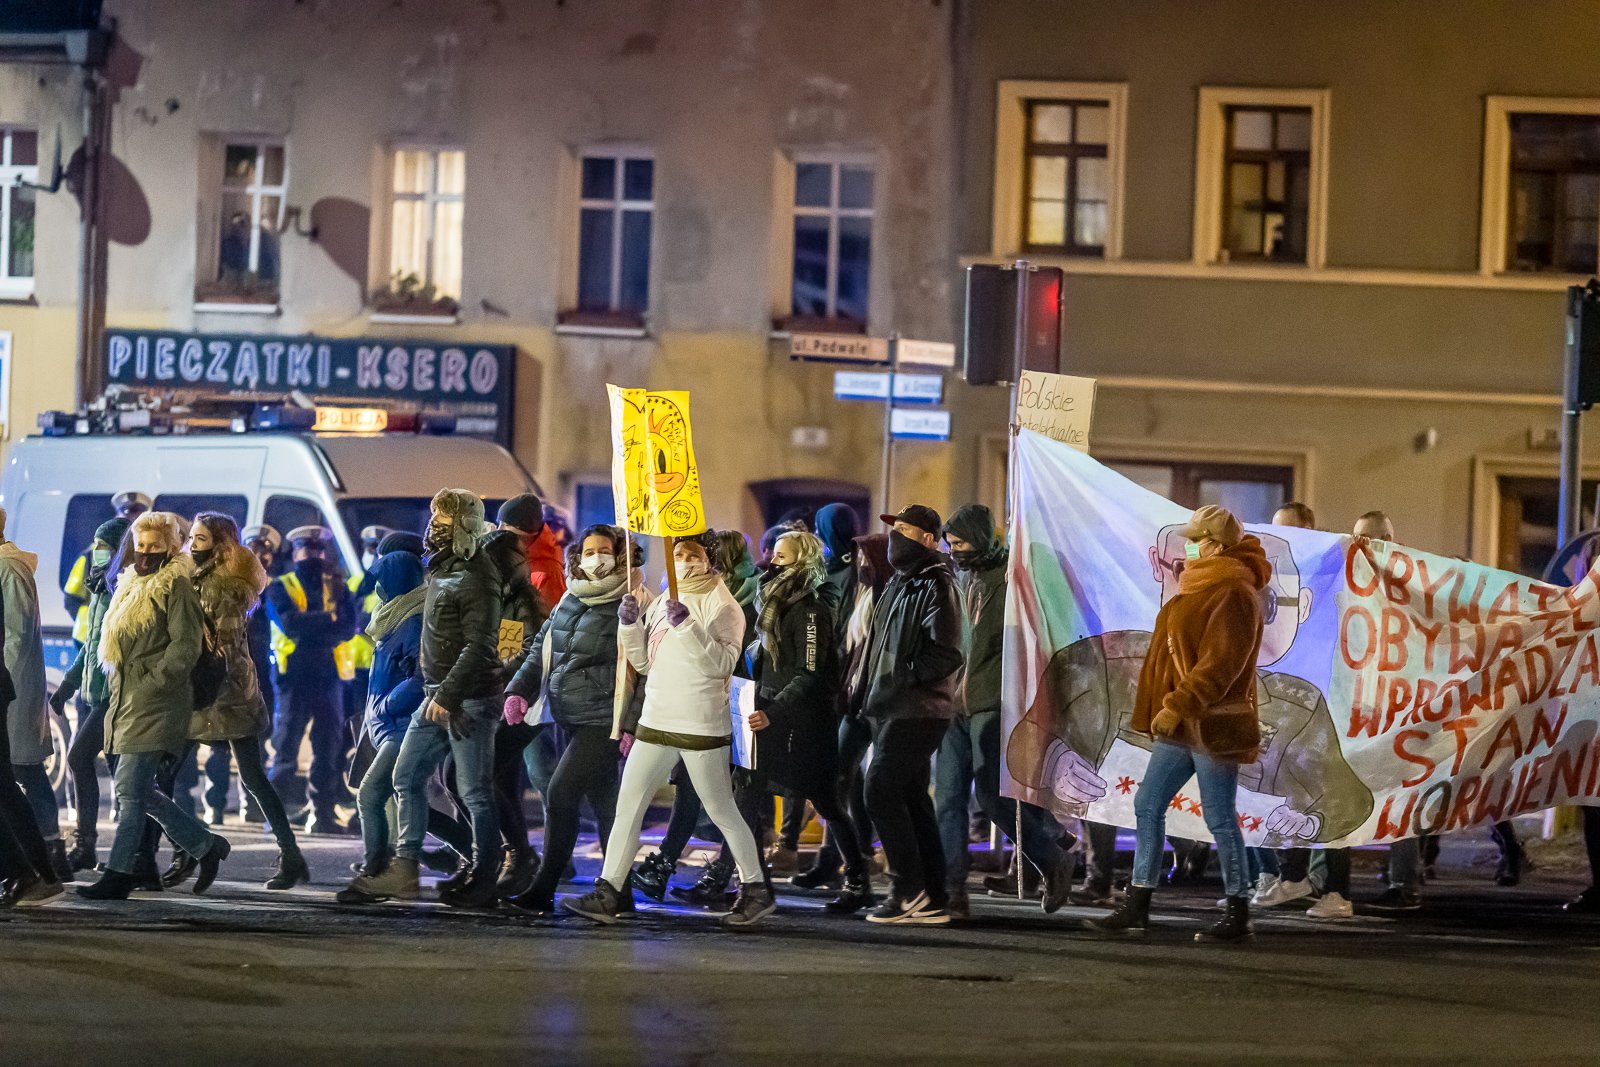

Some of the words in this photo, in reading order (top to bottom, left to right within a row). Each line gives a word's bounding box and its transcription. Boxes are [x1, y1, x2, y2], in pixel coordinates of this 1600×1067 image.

[1018, 377, 1074, 411] Polskie
[319, 411, 384, 428] POLICJA
[807, 625, 816, 644] STAY
[1393, 703, 1567, 788] STAN
